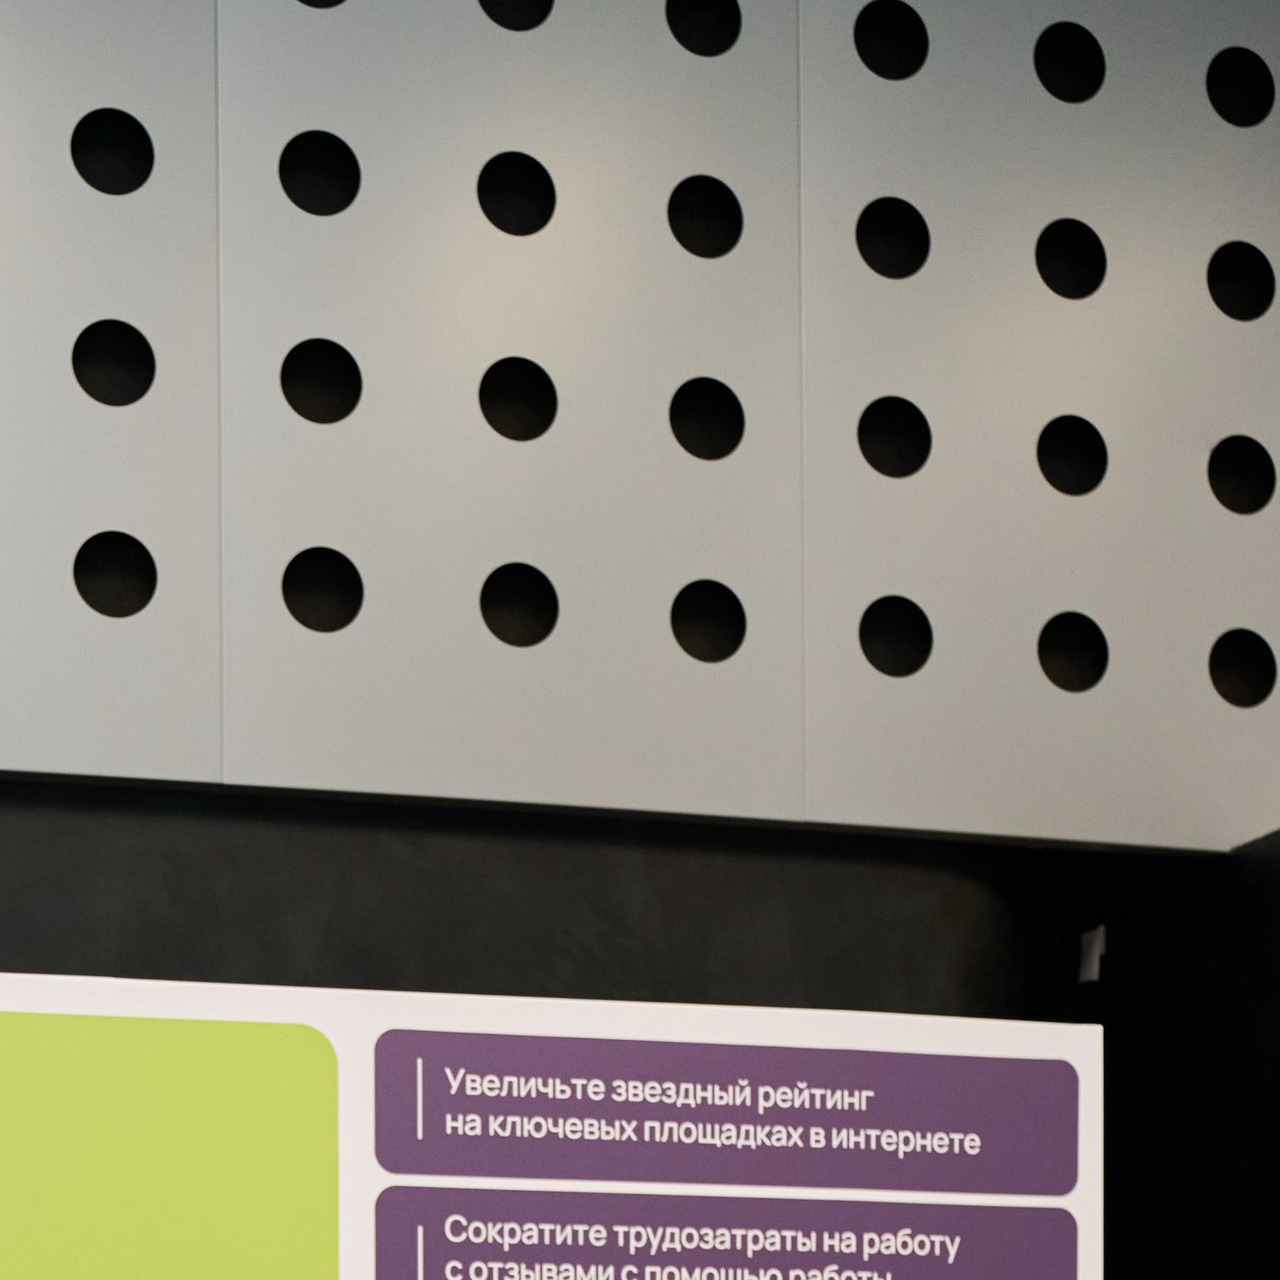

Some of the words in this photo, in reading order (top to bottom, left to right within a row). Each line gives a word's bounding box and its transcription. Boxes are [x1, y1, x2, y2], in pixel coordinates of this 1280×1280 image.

[444, 1067, 606, 1101] Увеличьте
[611, 1078, 752, 1108] звездный
[758, 1081, 875, 1115] рейтинг
[445, 1113, 482, 1136] на
[488, 1115, 638, 1142] ключевых
[644, 1120, 804, 1150] площадках
[809, 1126, 826, 1149] в
[831, 1128, 982, 1159] интернете
[444, 1214, 608, 1252] Сократите
[613, 1224, 817, 1258] трудозатраты
[823, 1231, 857, 1253] на
[863, 1228, 961, 1264] работу
